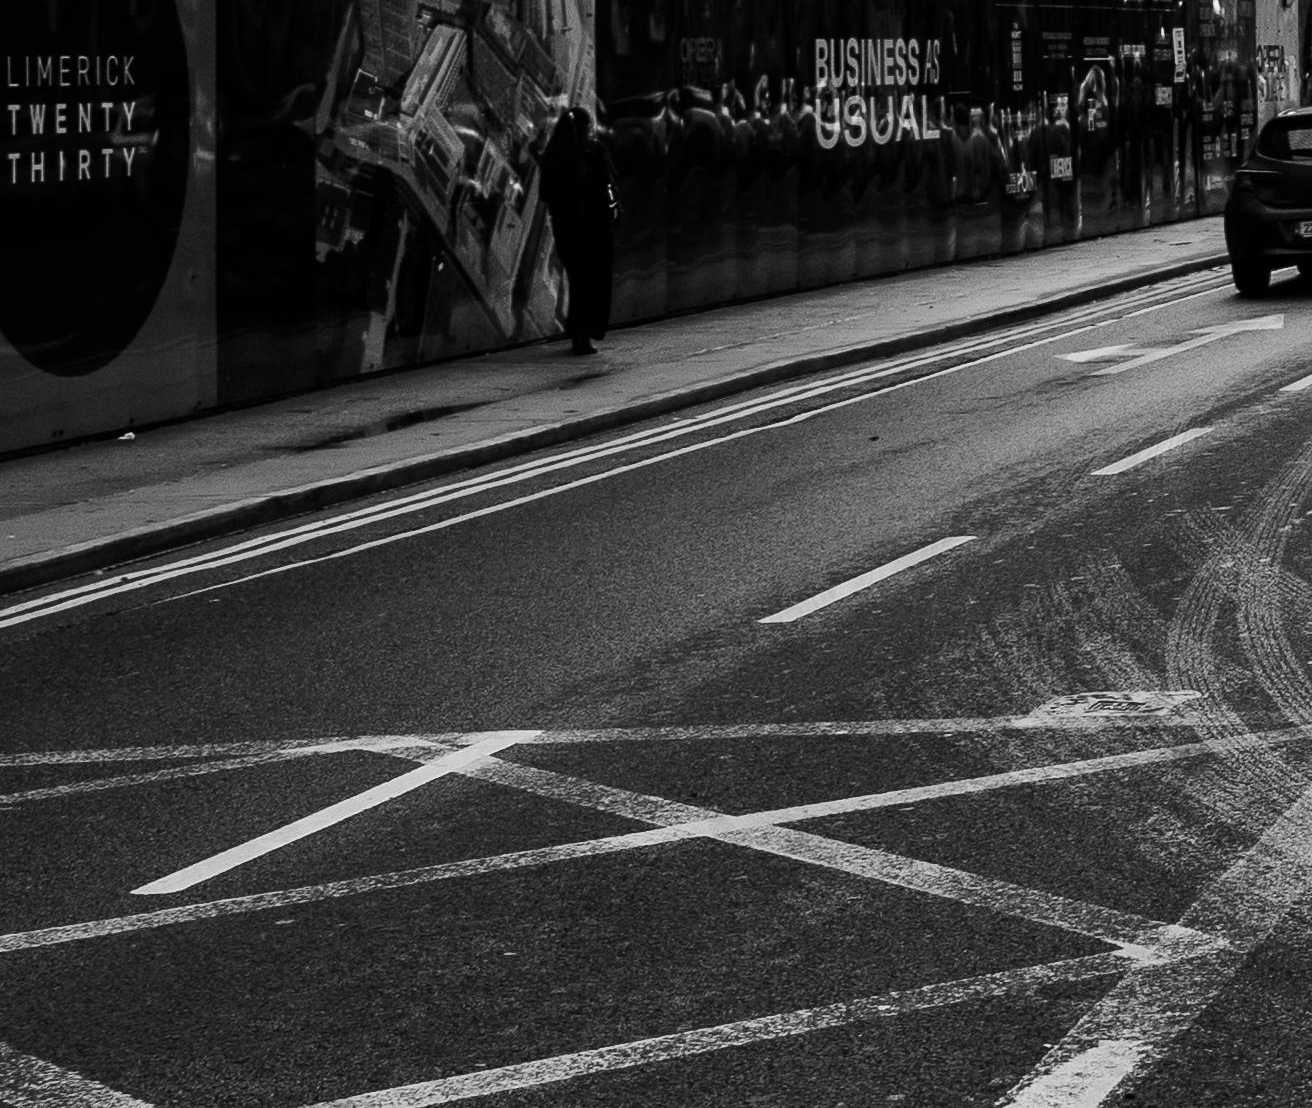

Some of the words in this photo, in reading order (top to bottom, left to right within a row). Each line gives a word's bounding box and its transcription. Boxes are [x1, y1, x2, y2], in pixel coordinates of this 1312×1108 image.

[6, 55, 136, 87] LIMERICK
[815, 38, 920, 88] BUSINESS
[923, 39, 941, 84] AS
[6, 101, 137, 136] TWENTY
[815, 93, 942, 150] USUAL
[6, 147, 137, 184] THIRTY
